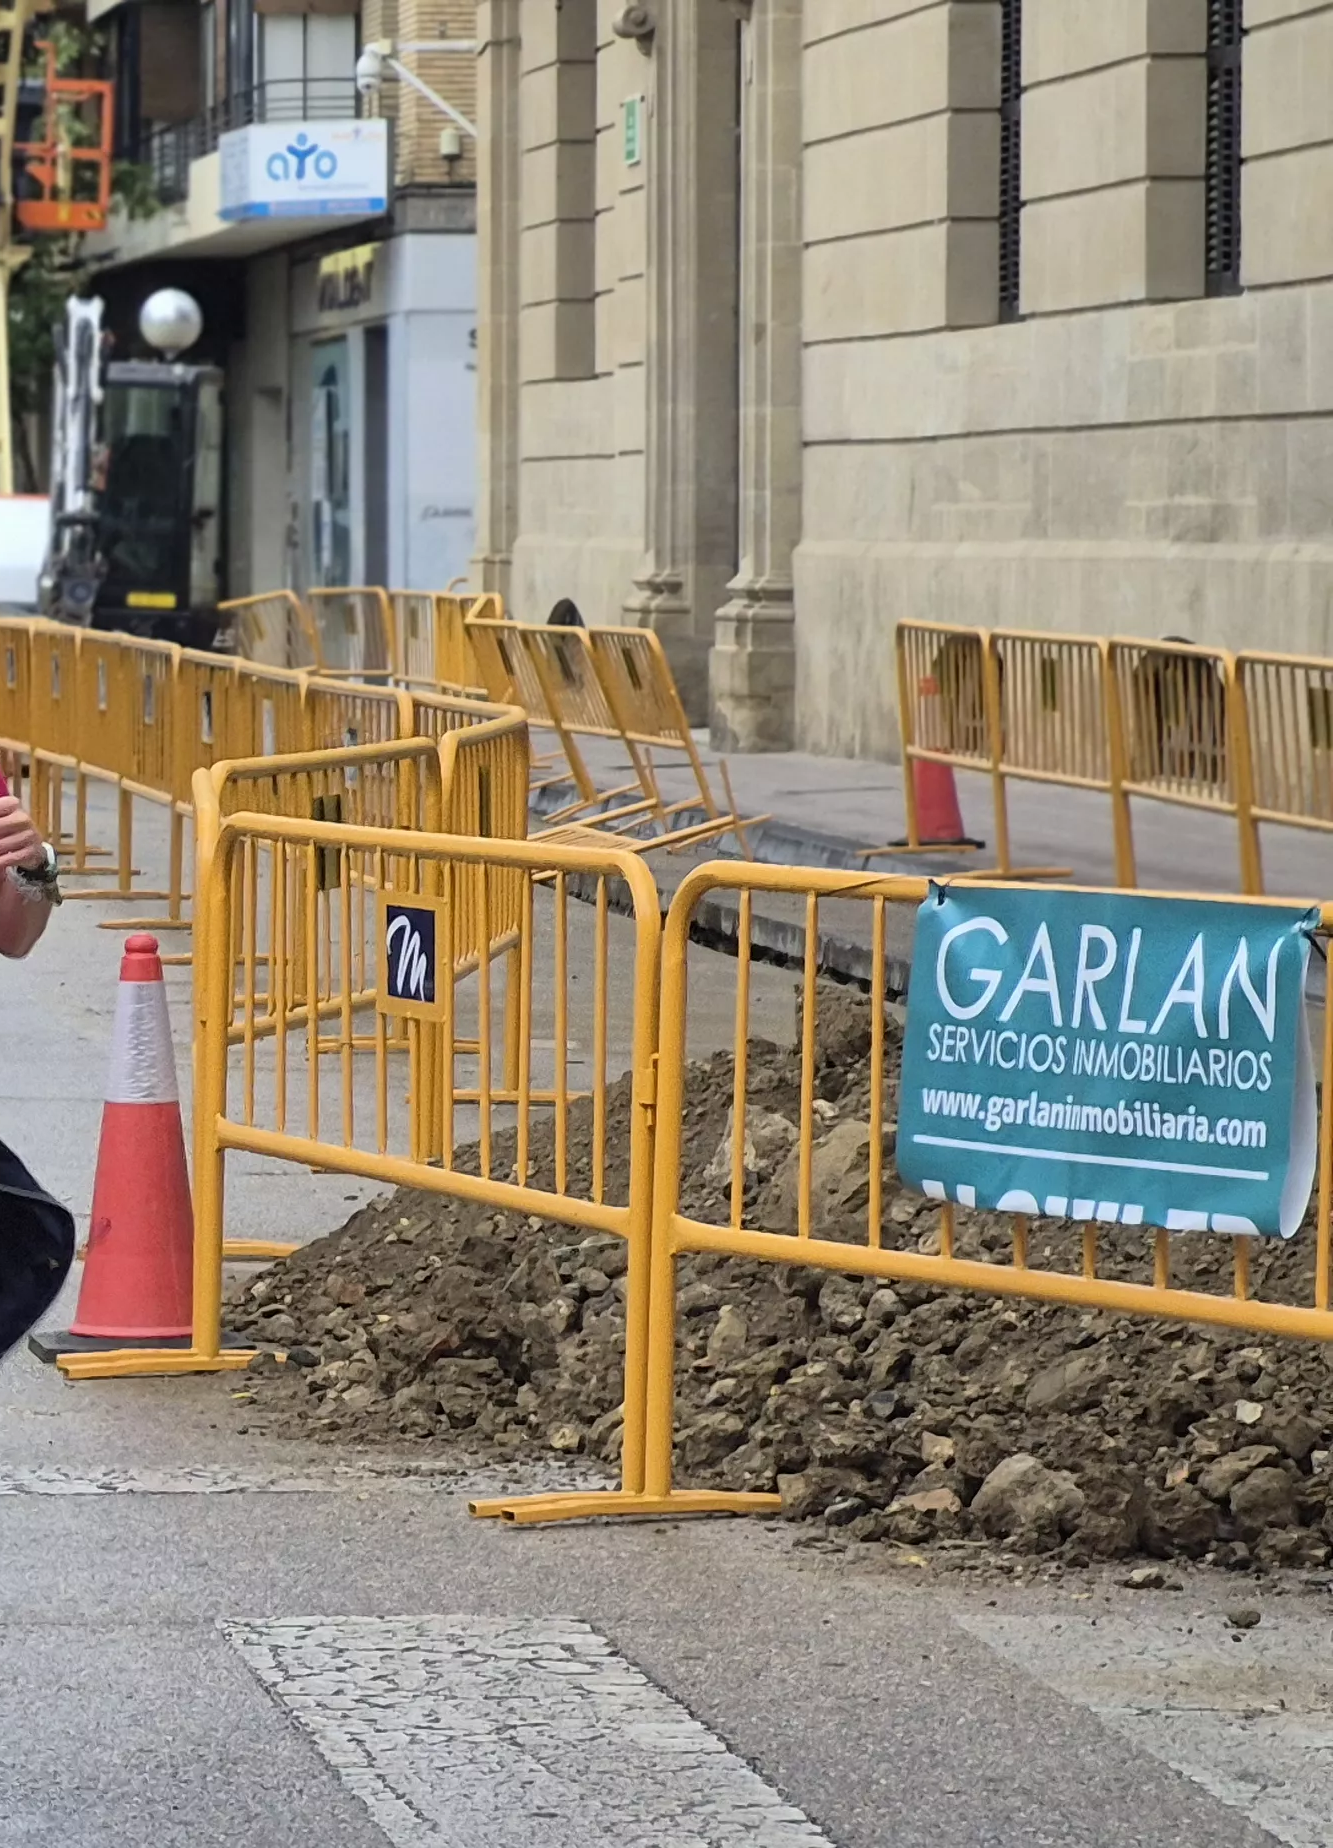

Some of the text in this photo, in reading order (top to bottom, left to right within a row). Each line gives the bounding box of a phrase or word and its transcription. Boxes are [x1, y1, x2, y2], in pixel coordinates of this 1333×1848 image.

[935, 916, 1286, 1043] GARLAN
[926, 1023, 1274, 1092] SERVICIOS INMOBILIARIOS
[921, 1086, 1268, 1149] www.garlaninmobiliaria.com
